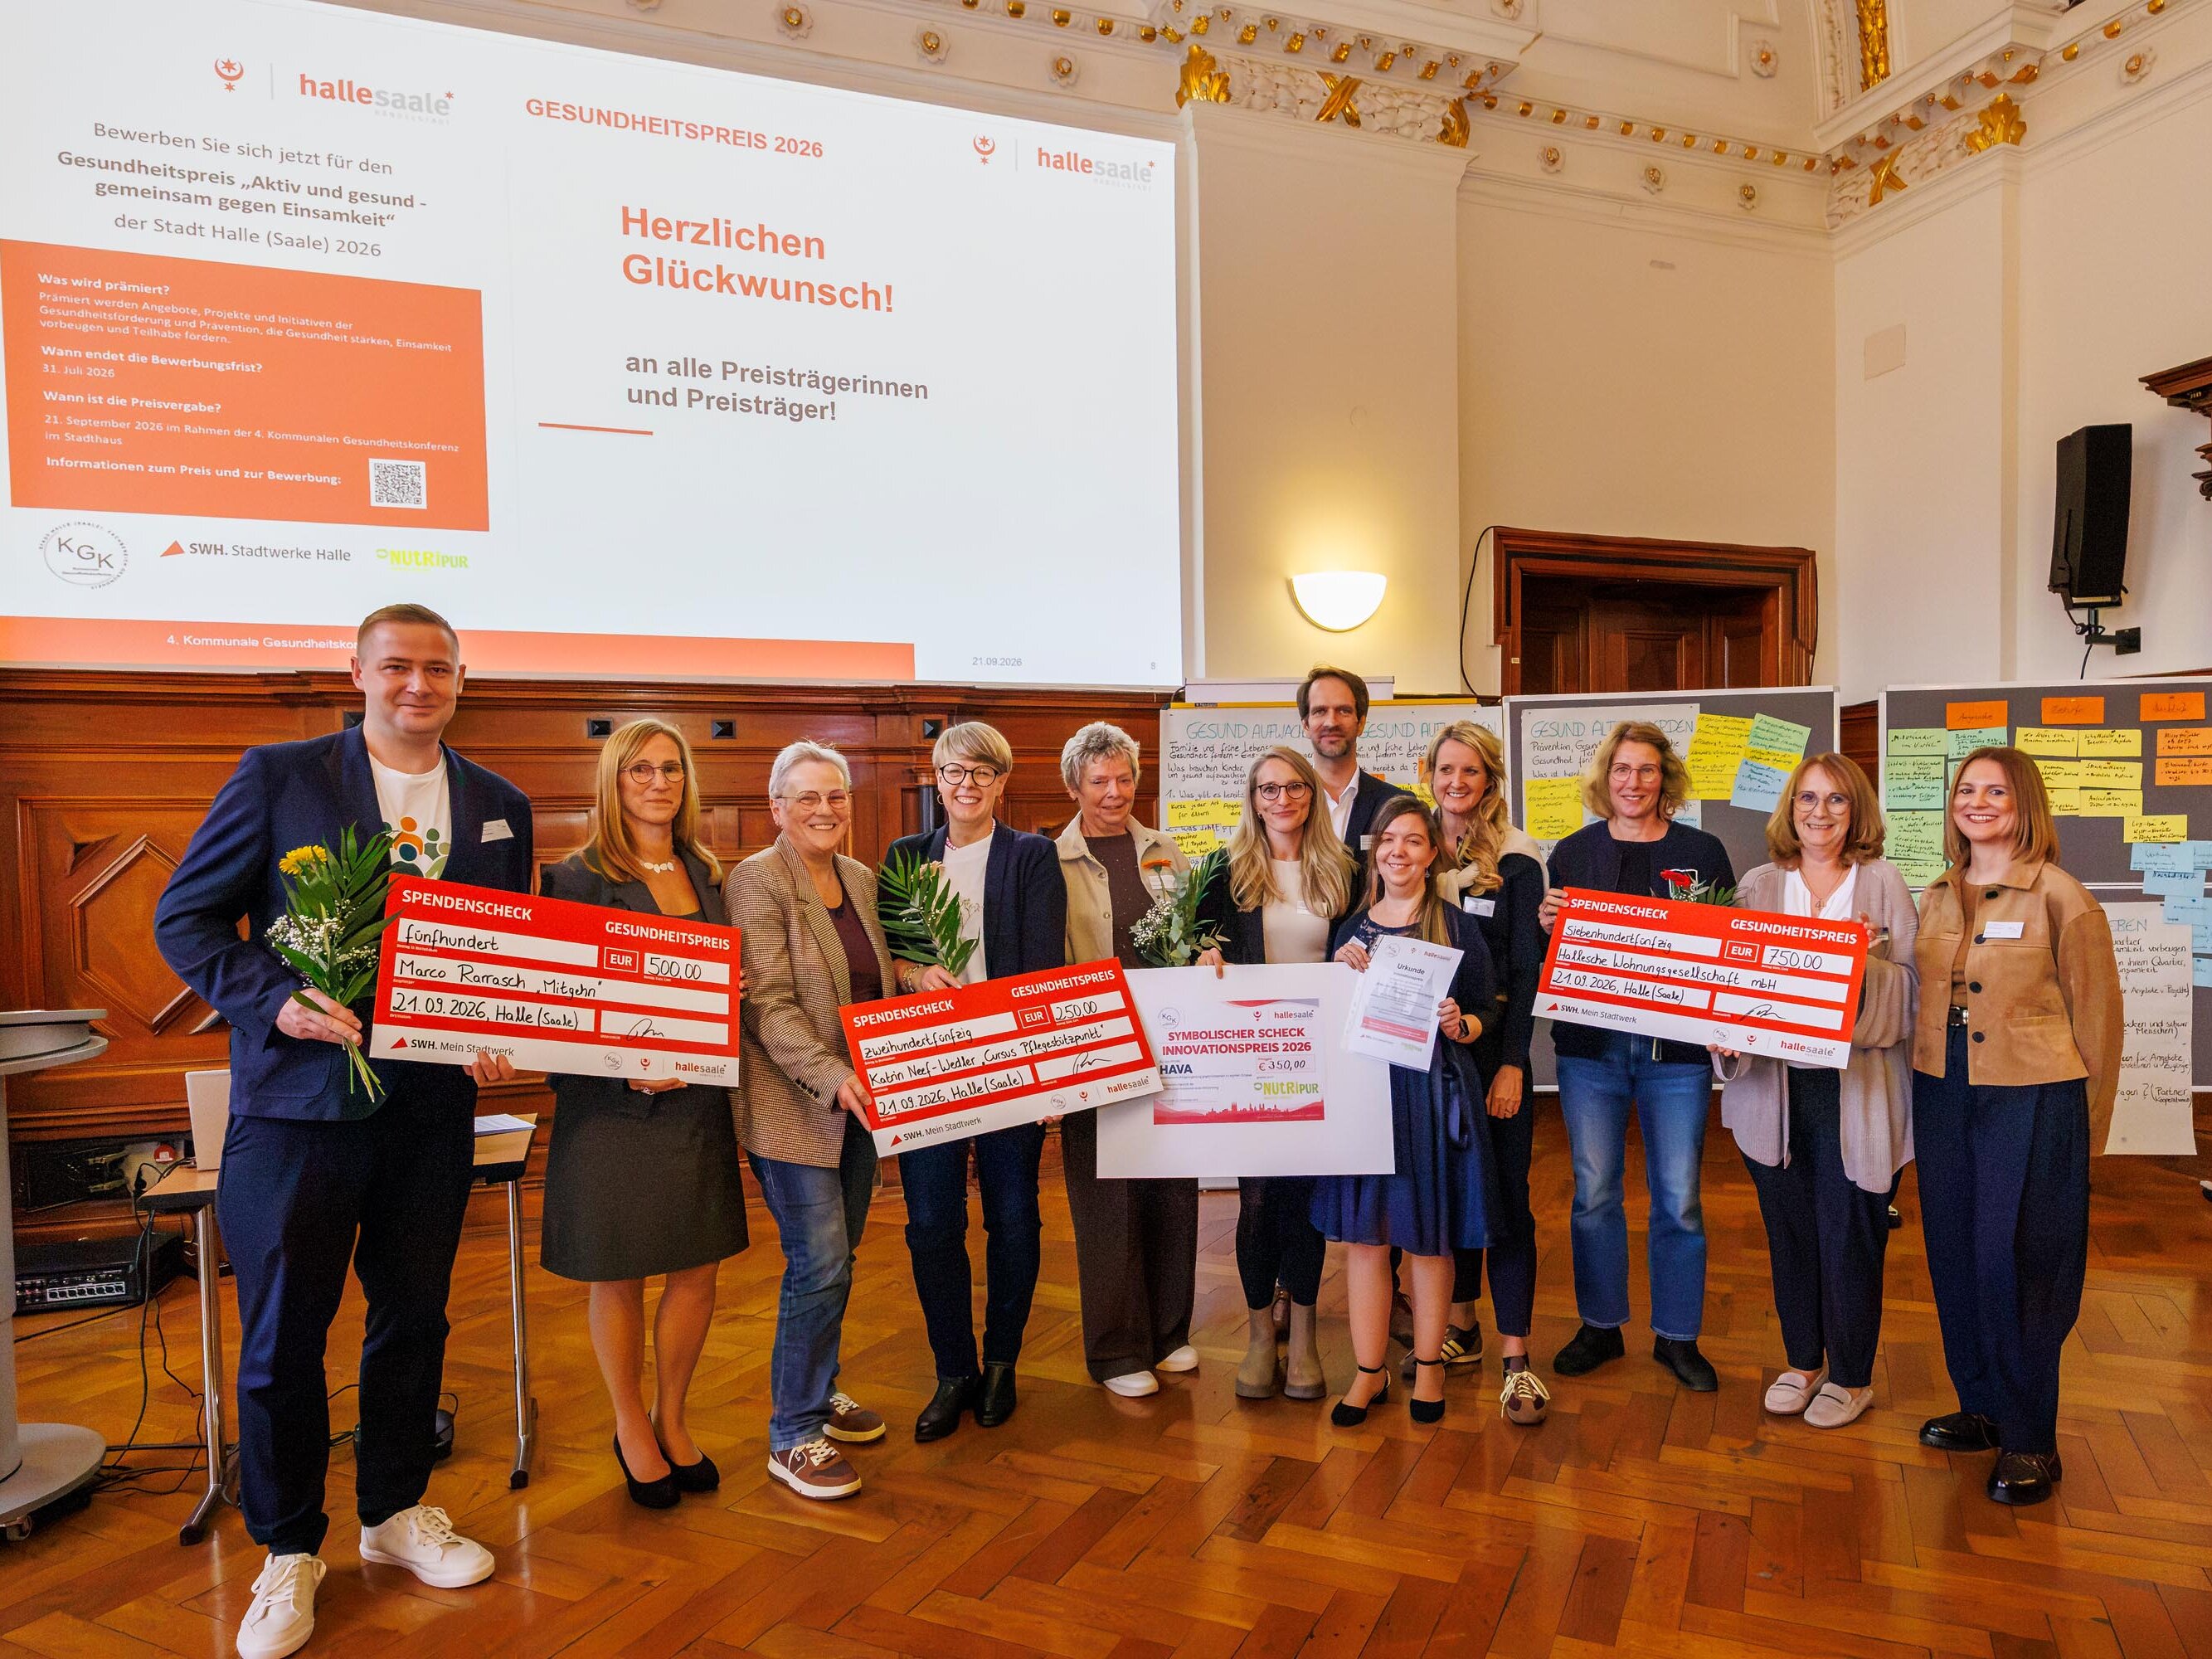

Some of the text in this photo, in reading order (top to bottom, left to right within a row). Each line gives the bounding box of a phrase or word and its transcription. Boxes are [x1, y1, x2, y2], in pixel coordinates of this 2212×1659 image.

[525, 98, 824, 158] GESUNDHEITSPREIS 2026
[94, 122, 392, 175] Bewerben Sie sich jetzt für den
[57, 151, 236, 186] Gesundheitspreis
[241, 175, 301, 193] „Aktiv
[307, 185, 343, 199] und
[348, 190, 414, 208] gesund
[95, 182, 395, 227] gemeinsam gegen Einsamkeit“
[114, 213, 382, 257] der Stadt Halle (Saale) 2026
[621, 205, 825, 260] Herzlichen
[37, 273, 170, 295] Was wird prämiert?
[622, 253, 893, 313] Glückwunsch!
[39, 291, 353, 330] Prämiert werden Angebote, Projekte und Initiativen der
[41, 345, 263, 373] Wann endet die Bewerbungsfrist?
[42, 363, 115, 377] 31. Juli 2026
[625, 356, 929, 400] an alle Preisträgerinnen
[43, 391, 221, 413] Wann ist die Preisvergabe?
[627, 385, 837, 423] und Preisträger!
[44, 414, 63, 425] 21.
[66, 416, 131, 430] September
[134, 421, 163, 432] 2026
[167, 423, 181, 433] im
[184, 424, 231, 436] Rahmen
[234, 428, 253, 438] der
[267, 431, 339, 445] Kommunalen
[343, 435, 460, 453] Gesundheitskonferenz
[45, 431, 124, 445] im Stadthaus
[46, 456, 342, 486] Informationen zum Preis und zur Bewerbung:
[58, 537, 114, 569] KGK
[189, 542, 352, 562] SWH. Stadtwerke Halle
[167, 635, 180, 645] 4.
[183, 635, 260, 648] Kommunale
[972, 656, 1023, 667] 21.09.2026
[1186, 721, 1248, 740] GESUND
[1530, 719, 1586, 738] GESUND
[1373, 761, 1396, 771] bereits
[1532, 755, 1573, 766] Gesundheit
[401, 888, 532, 922] SPENDENSCHECK
[1570, 898, 1669, 921] SPENDENSCHECK
[605, 921, 731, 951] GESUNDHEITSPREIS
[1730, 918, 1858, 945] GESUNDHEITSPREIS
[610, 953, 633, 966] EUR
[1731, 946, 1753, 956] EUR
[1768, 948, 1823, 971] 750,00
[399, 959, 446, 979] Marco
[648, 956, 702, 980] 500,00
[1397, 962, 1426, 975] Urkunde
[1558, 947, 1777, 990] Hallesche Wohnungsgesellschaft mbH
[1010, 969, 1116, 999] GESUNDHEITSPREIS
[1623, 980, 1650, 997] Halle
[495, 1004, 533, 1024] Halle
[537, 1006, 579, 1031] (Saale)
[853, 999, 955, 1028] SPENDENSCHECK
[1023, 1011, 1044, 1023] EUR
[1055, 1000, 1098, 1020] 250,00
[1560, 1005, 1638, 1024] SWH. Mein Stadtwerk
[1168, 1027, 1305, 1041] SYMBOLISCHER SCHECK
[411, 1039, 514, 1057] SWH. Mein Stadtwerk
[1162, 1041, 1312, 1056] INNOVATIONSPREIS 2026
[1159, 1063, 1194, 1075] HAVA
[1268, 1059, 1306, 1072] 350,00
[868, 1071, 904, 1087] Katrin
[950, 1082, 984, 1102] Halle
[984, 1070, 1024, 1095] (Saale)
[903, 1117, 982, 1141] SWH. Mein Stadtwerk
